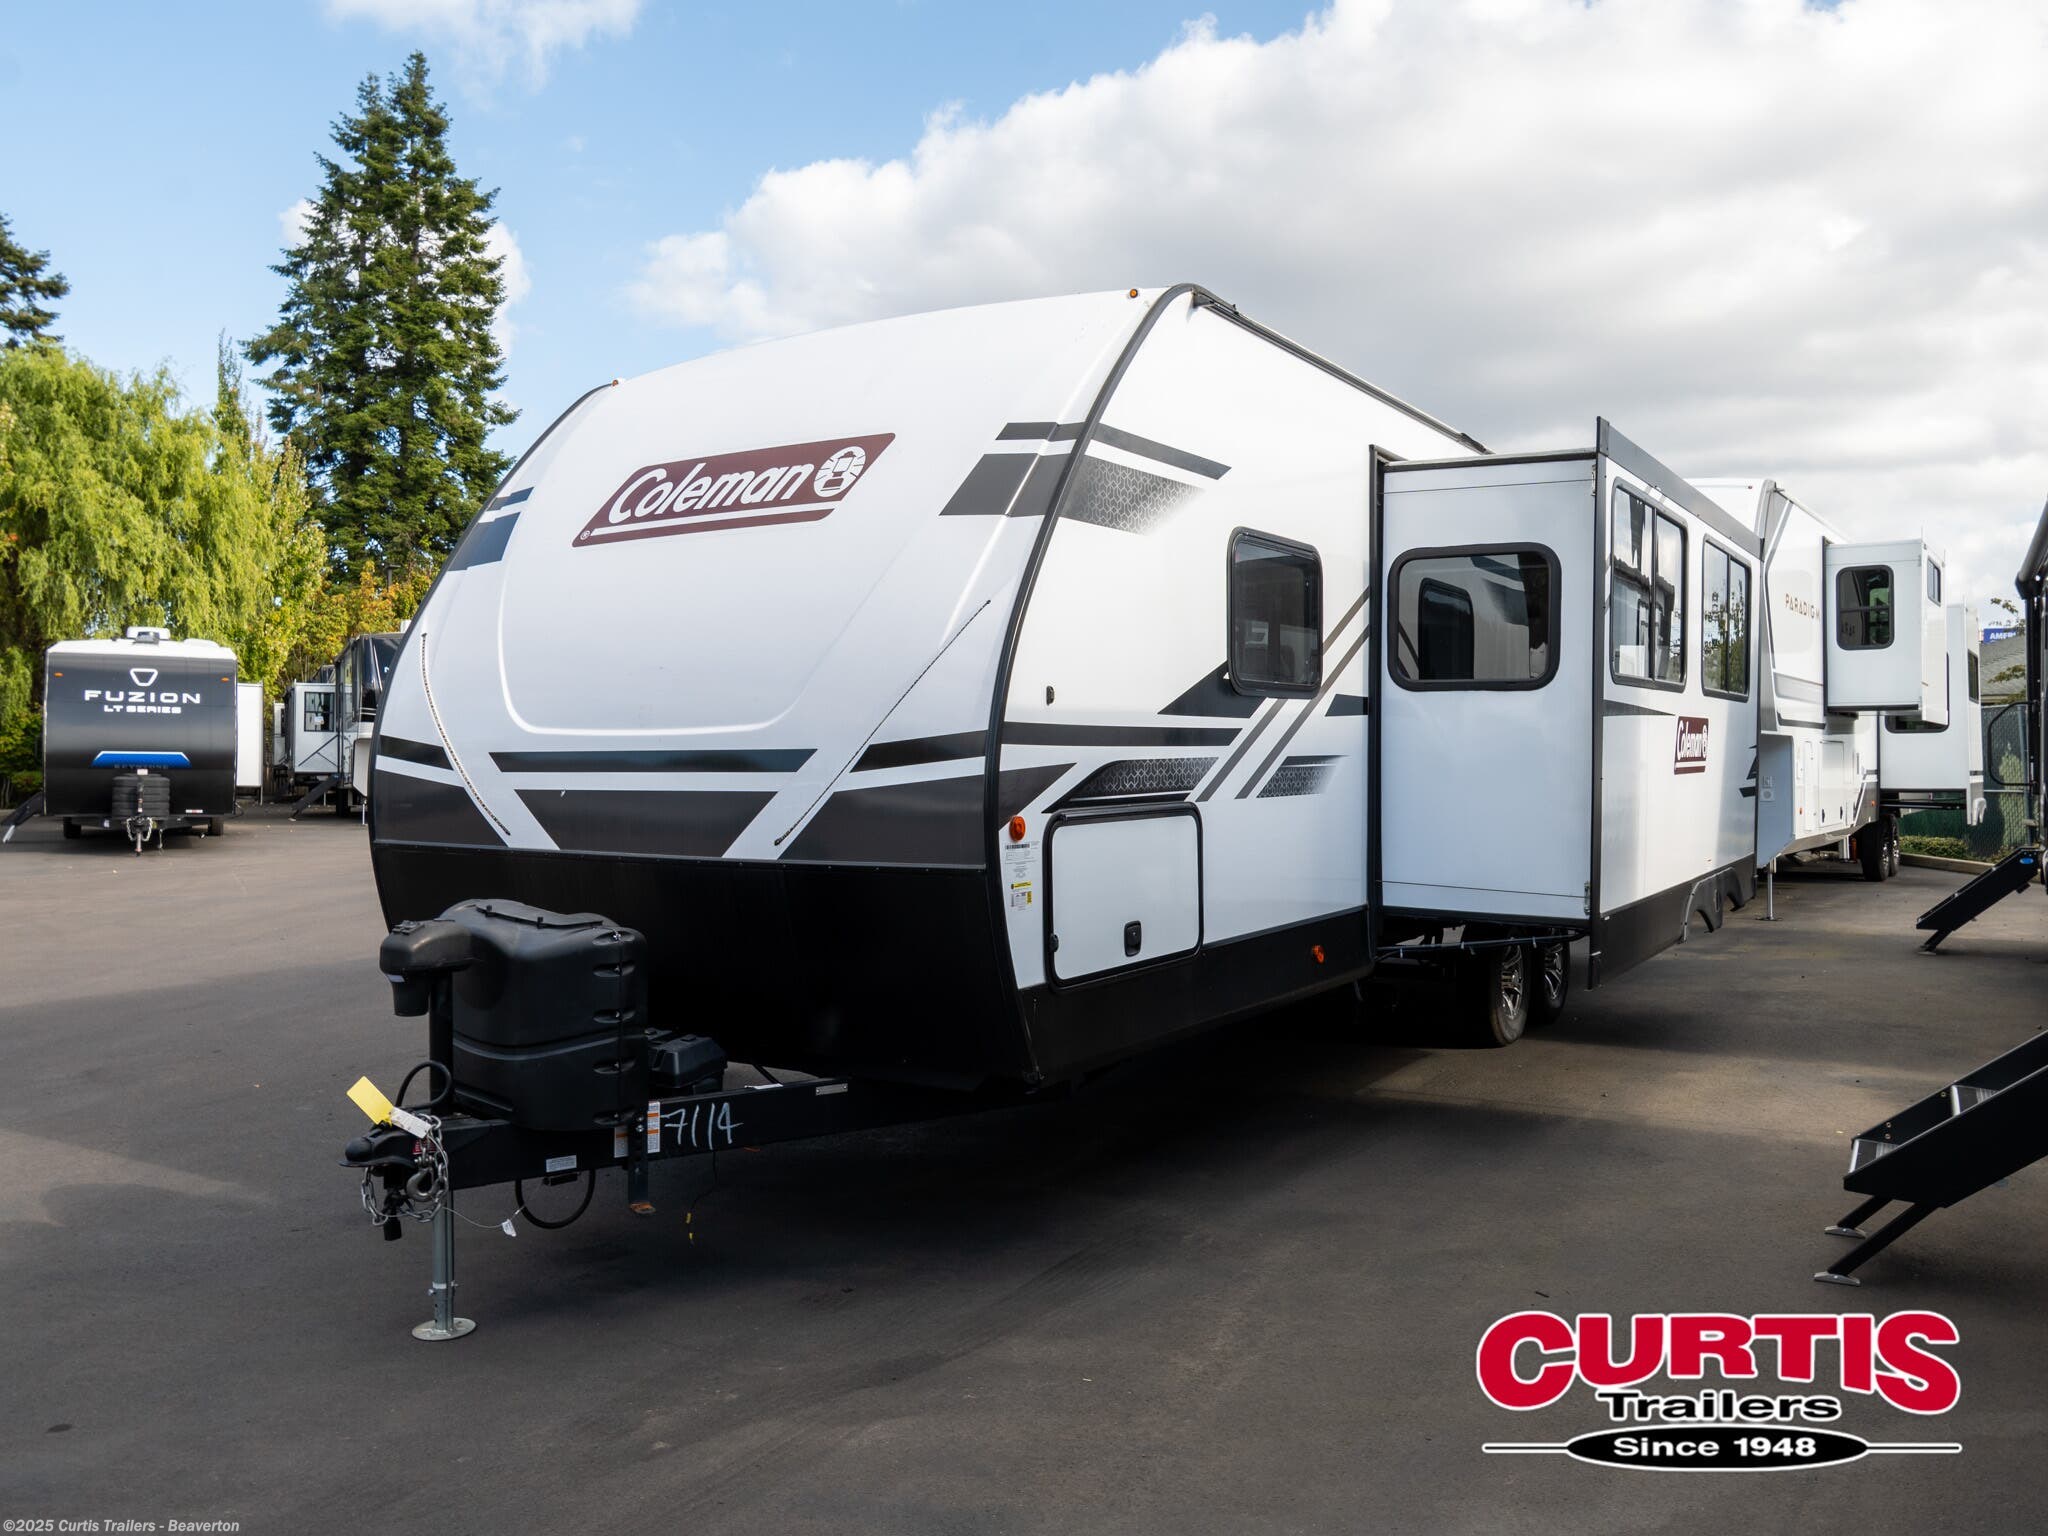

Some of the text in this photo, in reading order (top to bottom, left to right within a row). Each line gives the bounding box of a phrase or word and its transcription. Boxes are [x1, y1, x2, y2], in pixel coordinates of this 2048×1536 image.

[608, 462, 815, 524] Coleman
[1785, 592, 1821, 622] PARADIGM
[84, 689, 201, 704] FUZION
[103, 704, 182, 714] LT SERIES
[659, 1101, 745, 1151] 7114
